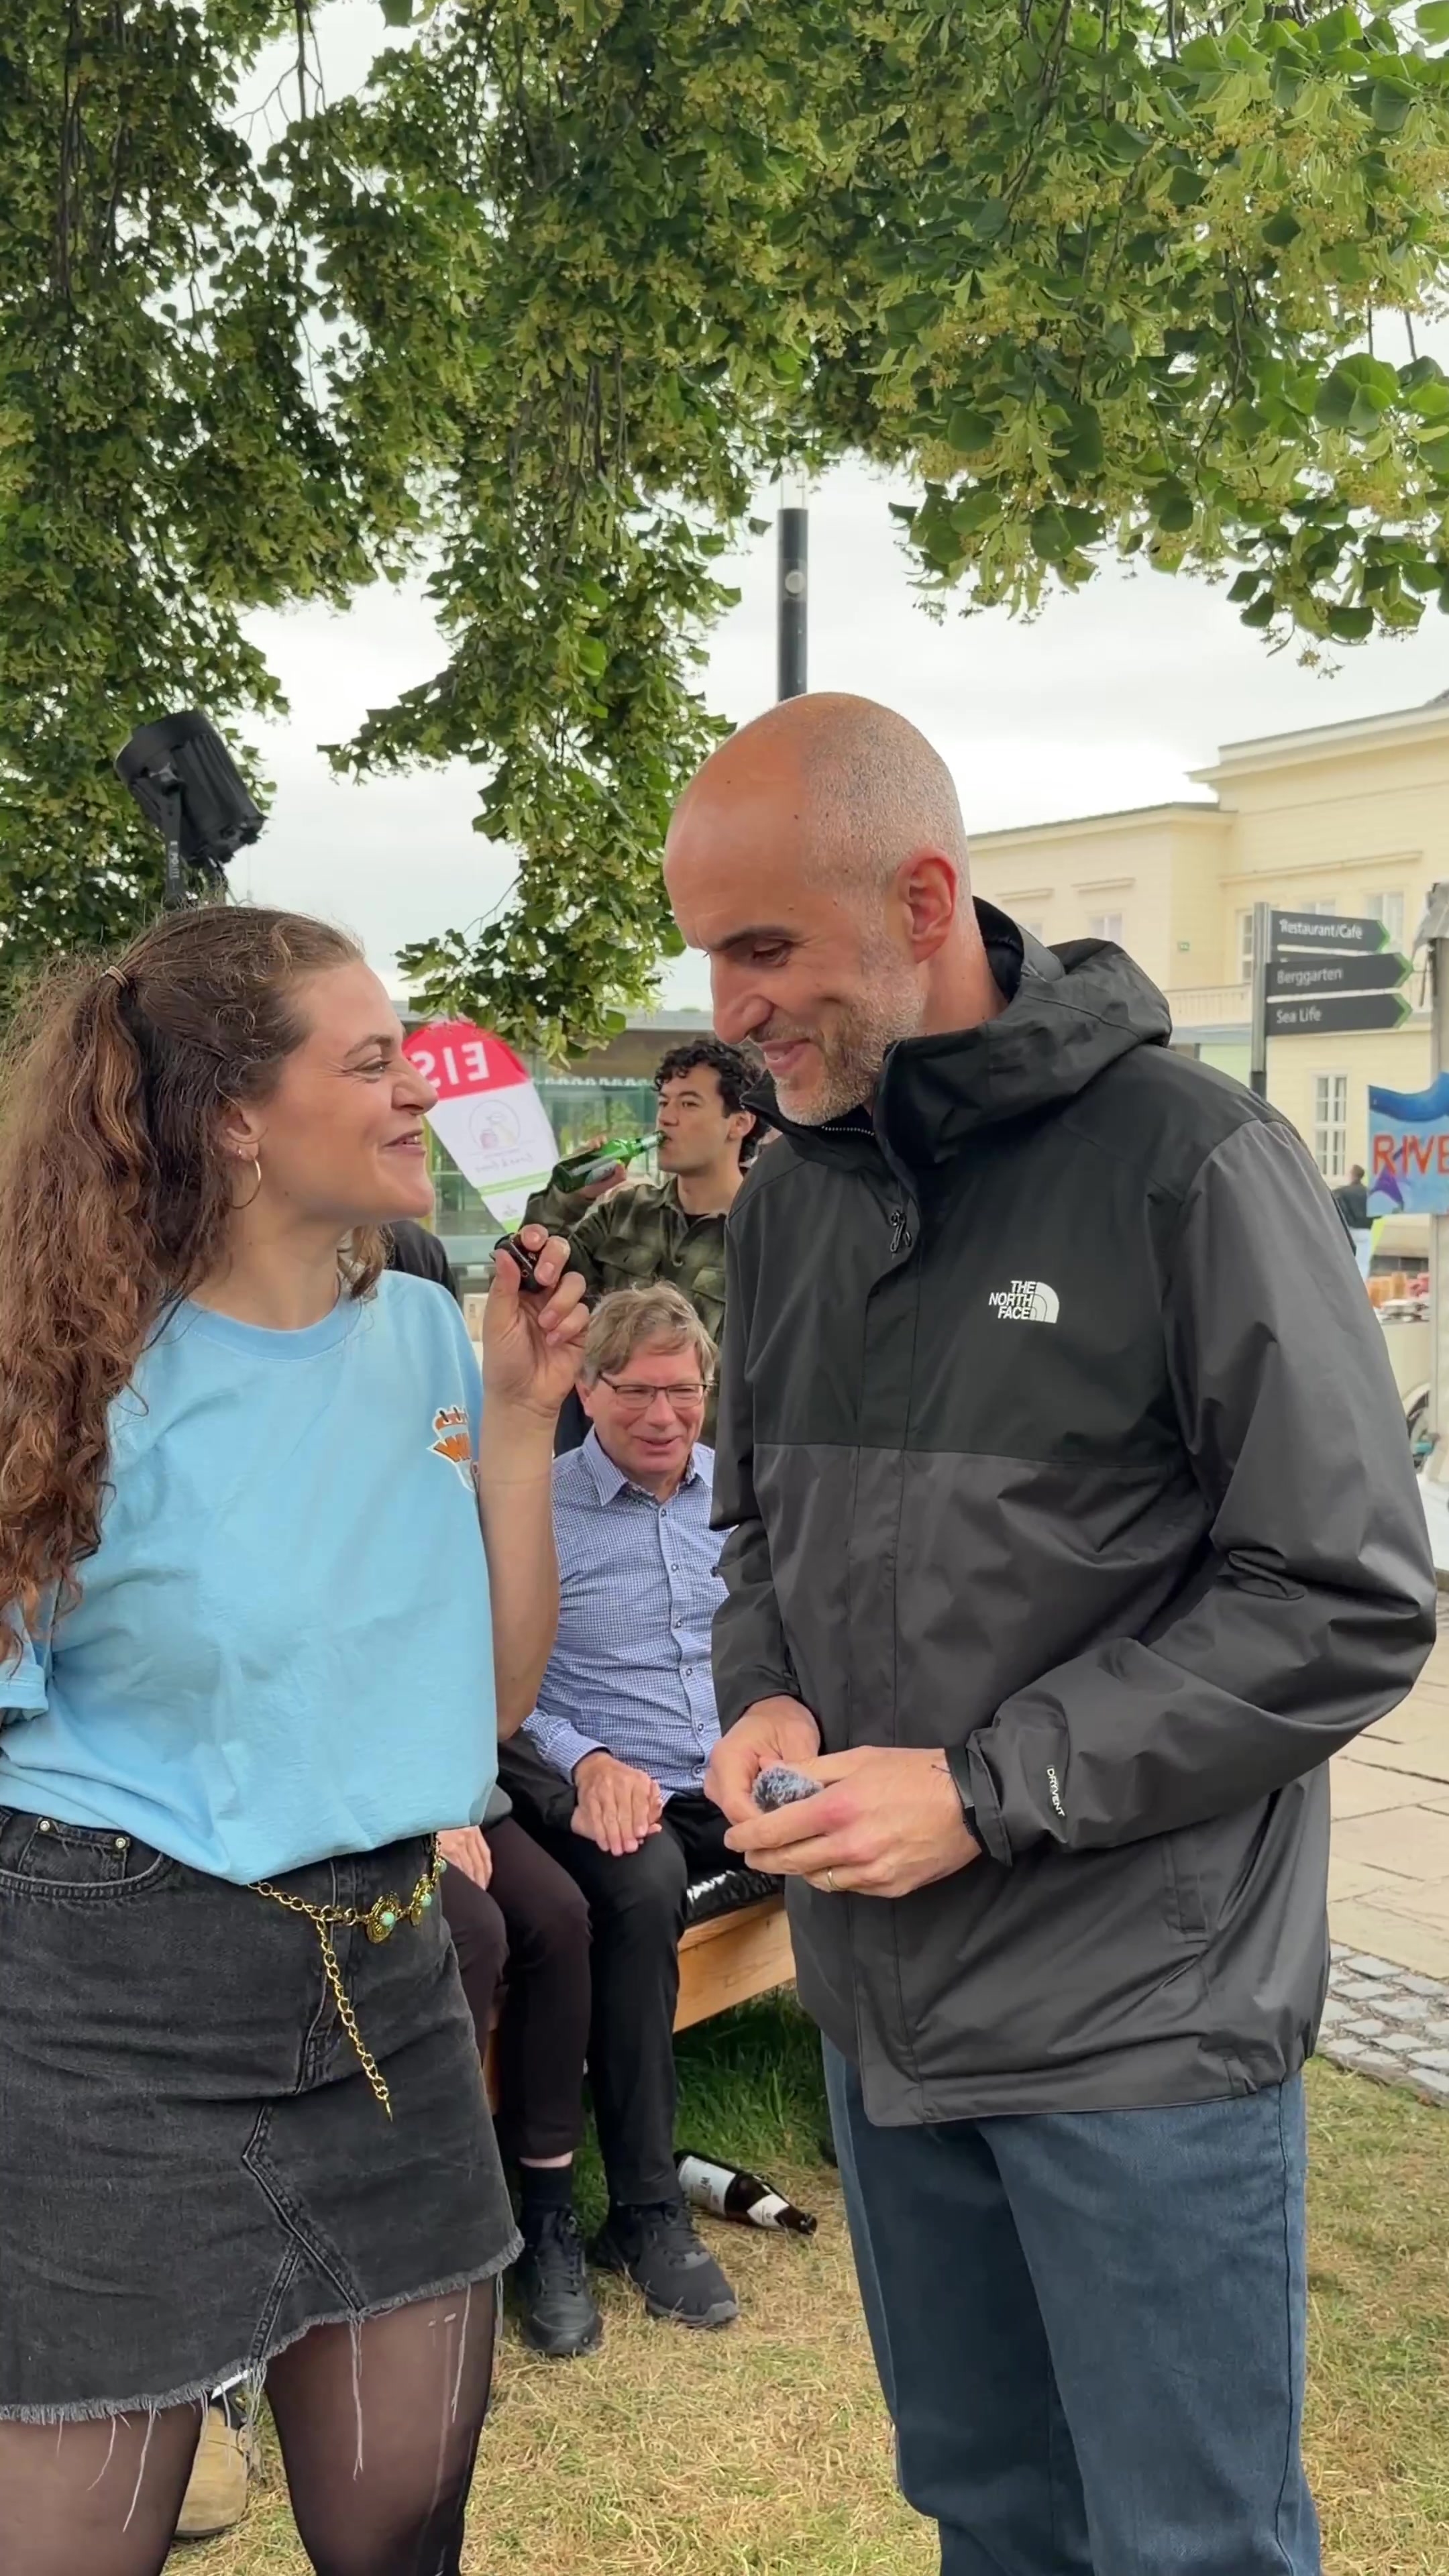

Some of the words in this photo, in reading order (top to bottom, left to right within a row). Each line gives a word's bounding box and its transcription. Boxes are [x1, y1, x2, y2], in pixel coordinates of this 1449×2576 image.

[1277, 968, 1343, 986] Berggarten
[1277, 1009, 1297, 1024] Sea
[1299, 1006, 1322, 1022] Life
[1010, 1281, 1036, 1294] THE
[988, 1292, 1033, 1307] NORTH
[998, 1306, 1030, 1320] FACE
[1046, 1768, 1065, 1817] DRYVENT
